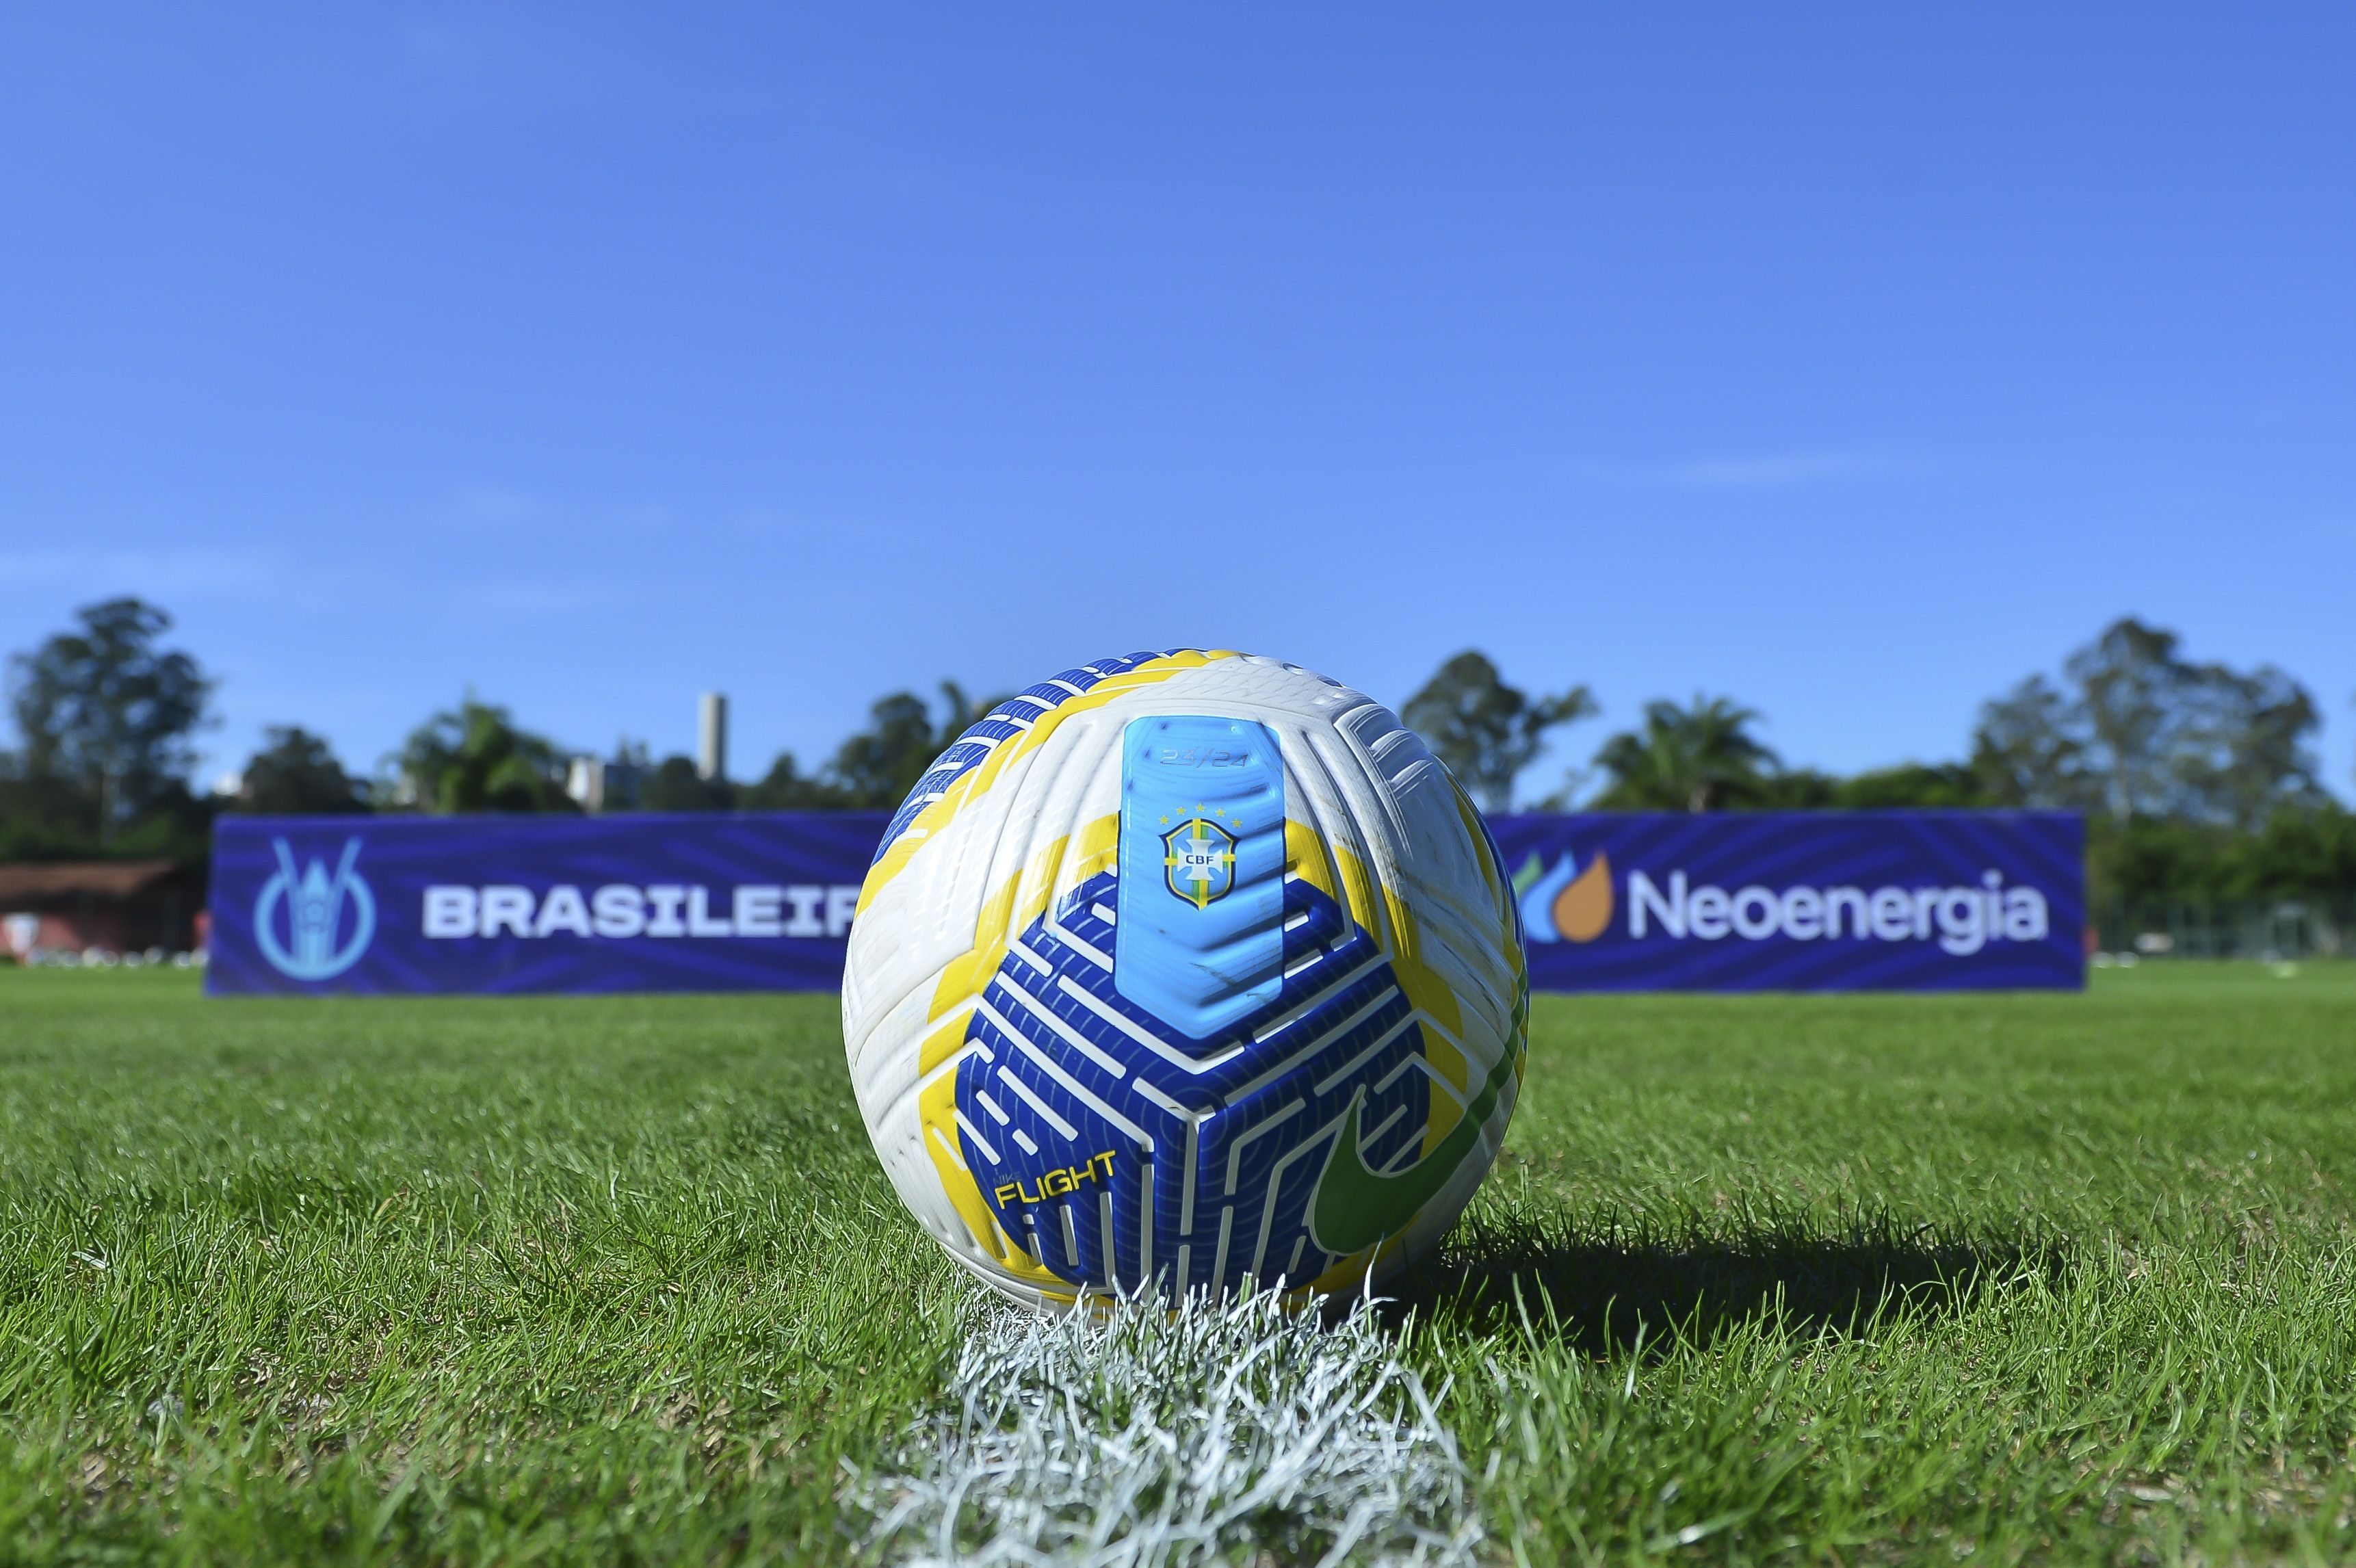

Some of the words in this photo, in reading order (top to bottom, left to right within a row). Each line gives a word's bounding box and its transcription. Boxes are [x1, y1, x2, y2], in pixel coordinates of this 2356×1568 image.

[1186, 854, 1214, 865] CBF
[1628, 871, 2047, 954] Neoenergia
[995, 1149, 1116, 1210] FLIGHT
